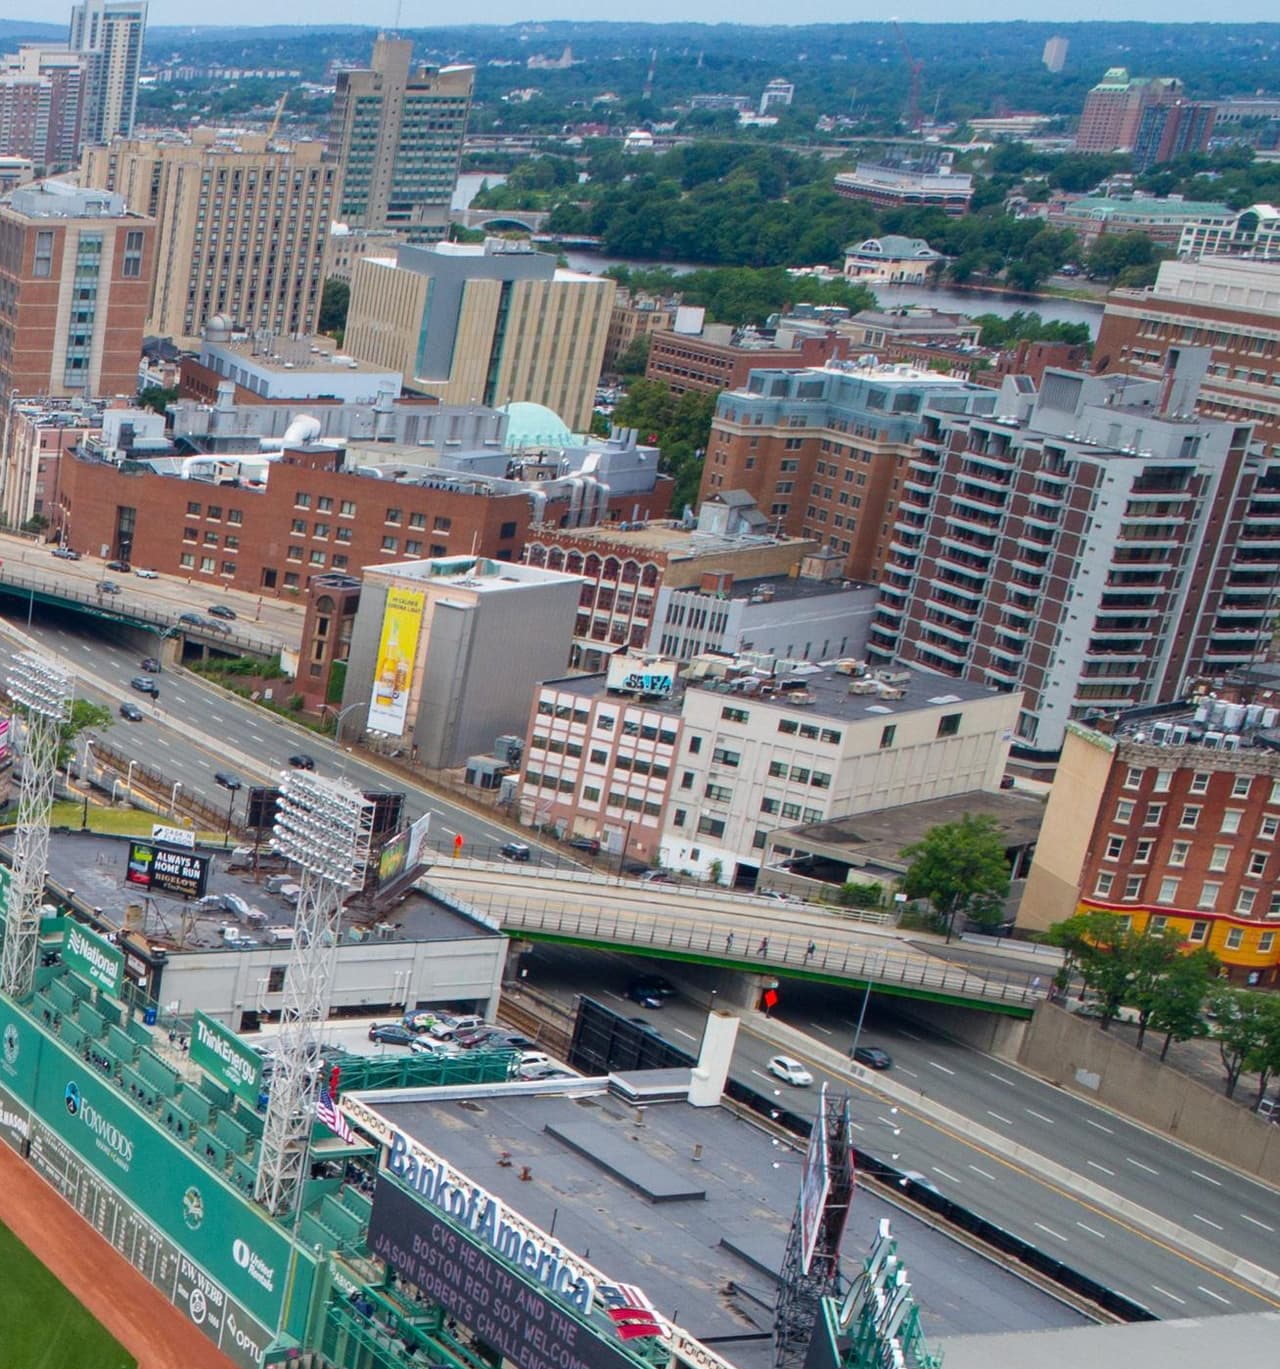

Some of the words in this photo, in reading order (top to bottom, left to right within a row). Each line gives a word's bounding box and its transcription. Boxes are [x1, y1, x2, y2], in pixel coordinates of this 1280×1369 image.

[154, 861, 180, 874] HOME
[182, 867, 201, 879] RUN
[156, 851, 191, 867] ALWAYS
[193, 860, 200, 869] A
[79, 938, 119, 980] National
[198, 1020, 256, 1085] ThinkEnergy
[79, 1097, 135, 1162] FOXWOODS
[389, 1130, 451, 1212] Bank
[449, 1188, 481, 1231] of
[477, 1198, 595, 1315] America
[197, 1274, 224, 1308] WEBB
[375, 1233, 415, 1275] JASON
[417, 1266, 473, 1322] ROBERTS
[413, 1234, 462, 1289] BOSTON
[464, 1274, 490, 1307] RED
[493, 1297, 521, 1332] SOX
[431, 1223, 457, 1253] CVS
[460, 1243, 513, 1299] HEALTH
[518, 1290, 545, 1320] AND
[551, 1311, 578, 1346] THE
[235, 1330, 264, 1364] OPTU
